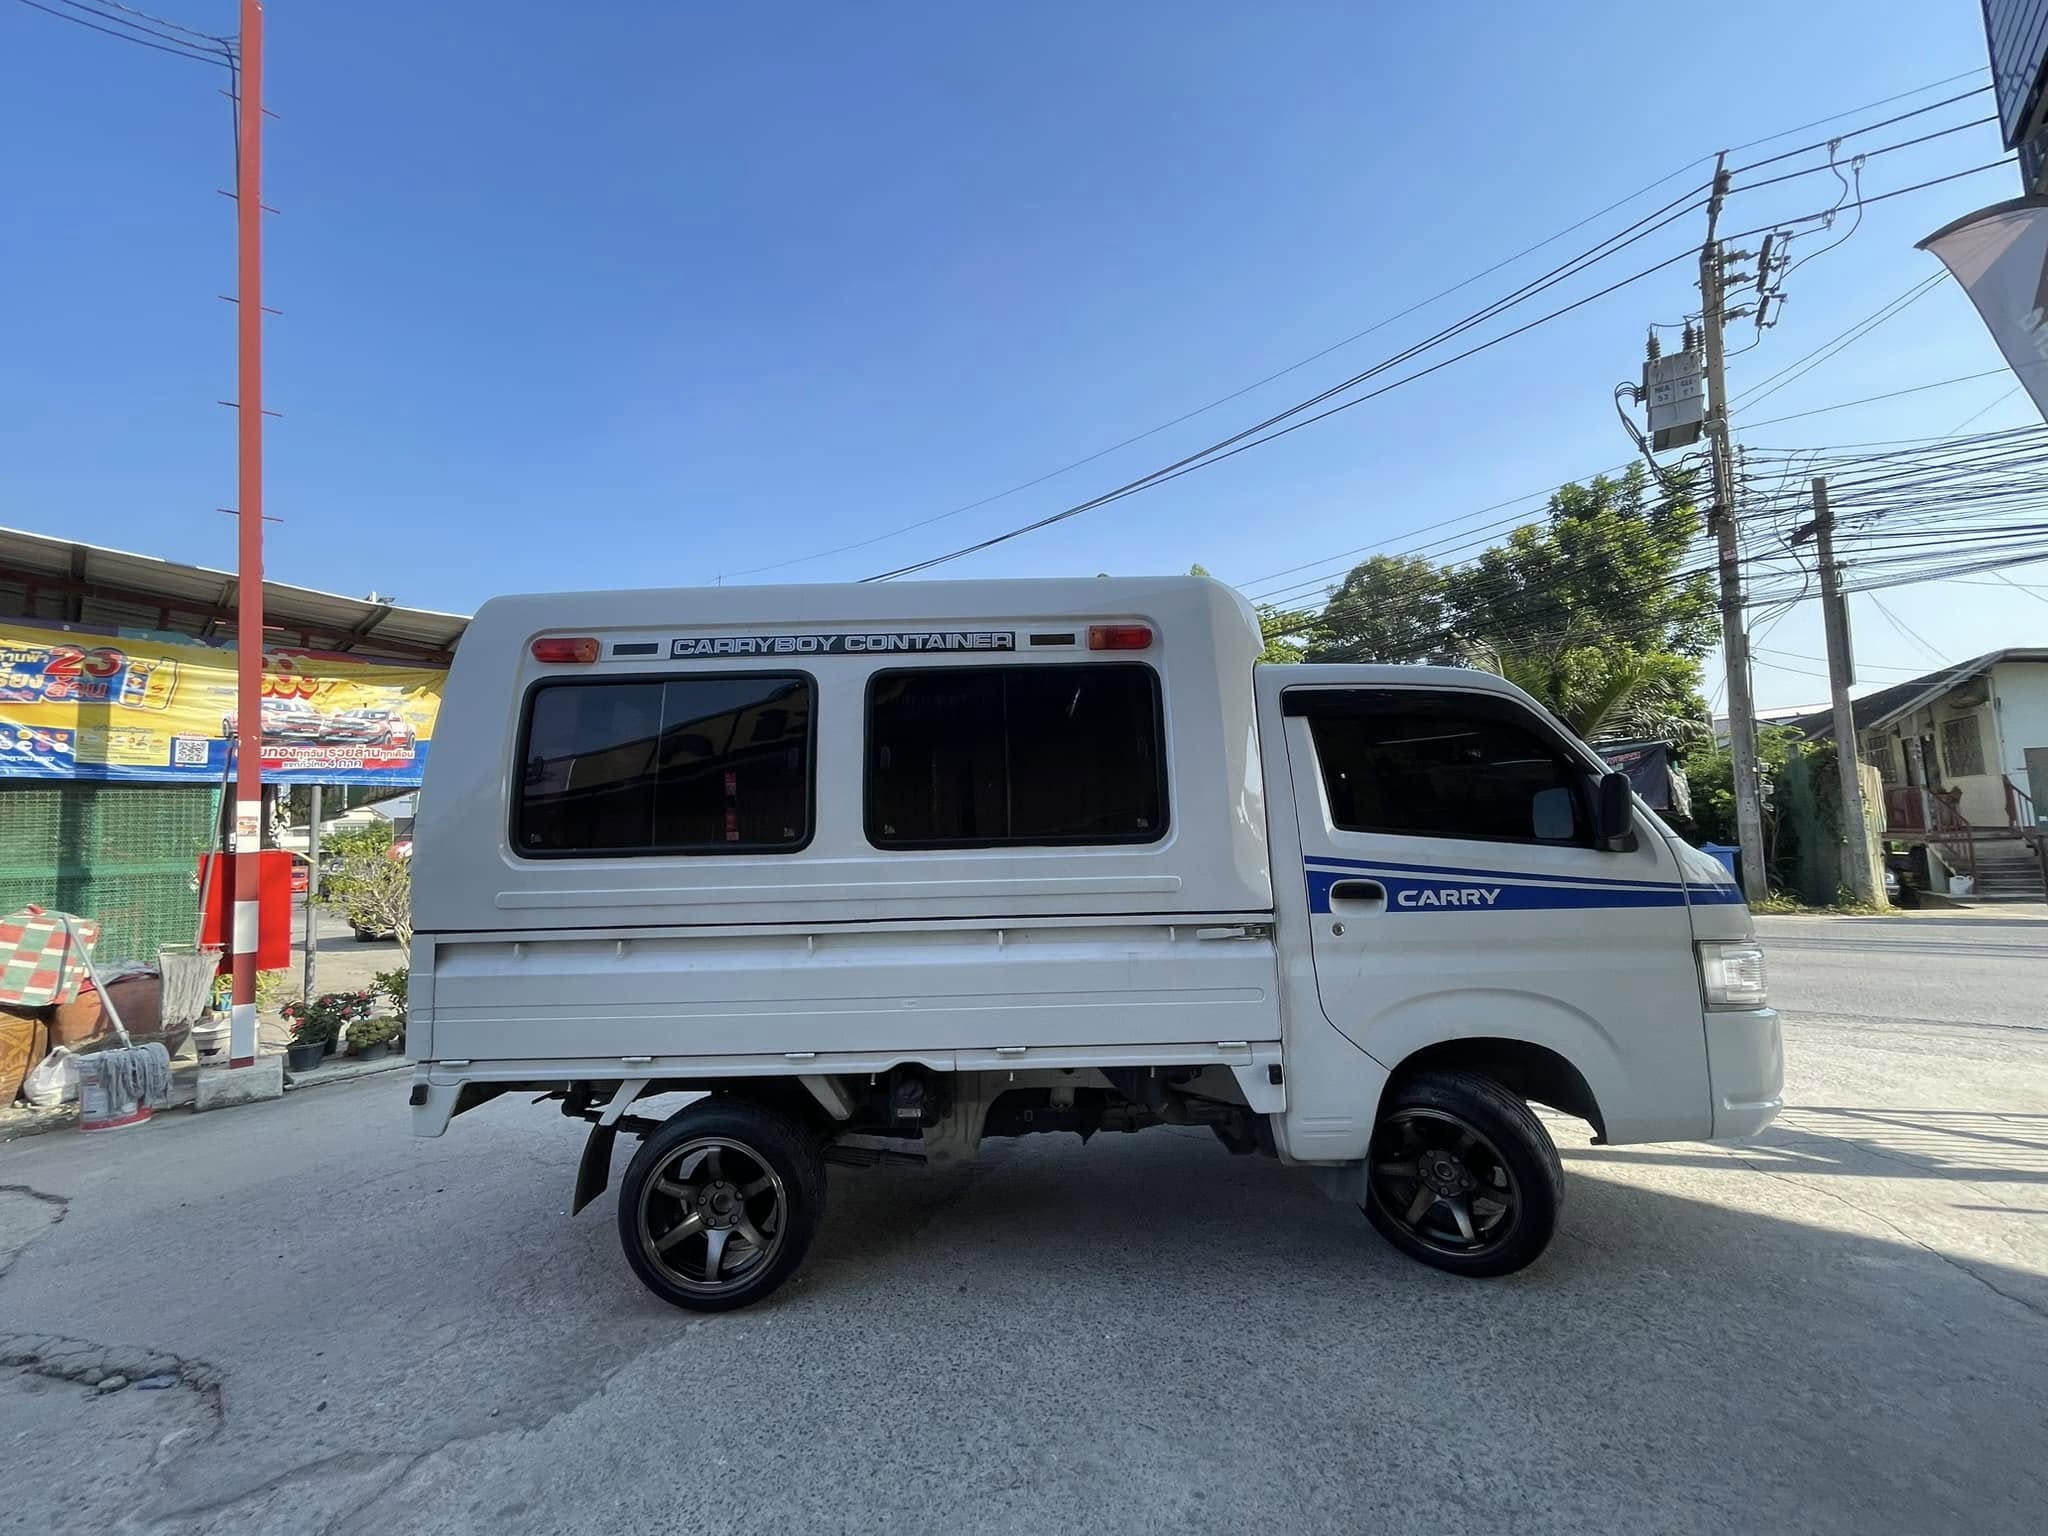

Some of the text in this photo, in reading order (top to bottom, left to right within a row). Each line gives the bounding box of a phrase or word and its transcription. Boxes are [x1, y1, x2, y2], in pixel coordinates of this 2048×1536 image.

[673, 633, 1012, 655] CARRYBOY CONTAINER
[43, 645, 125, 677] 23
[327, 759, 336, 768] 4
[1397, 888, 1501, 907] CARRY
